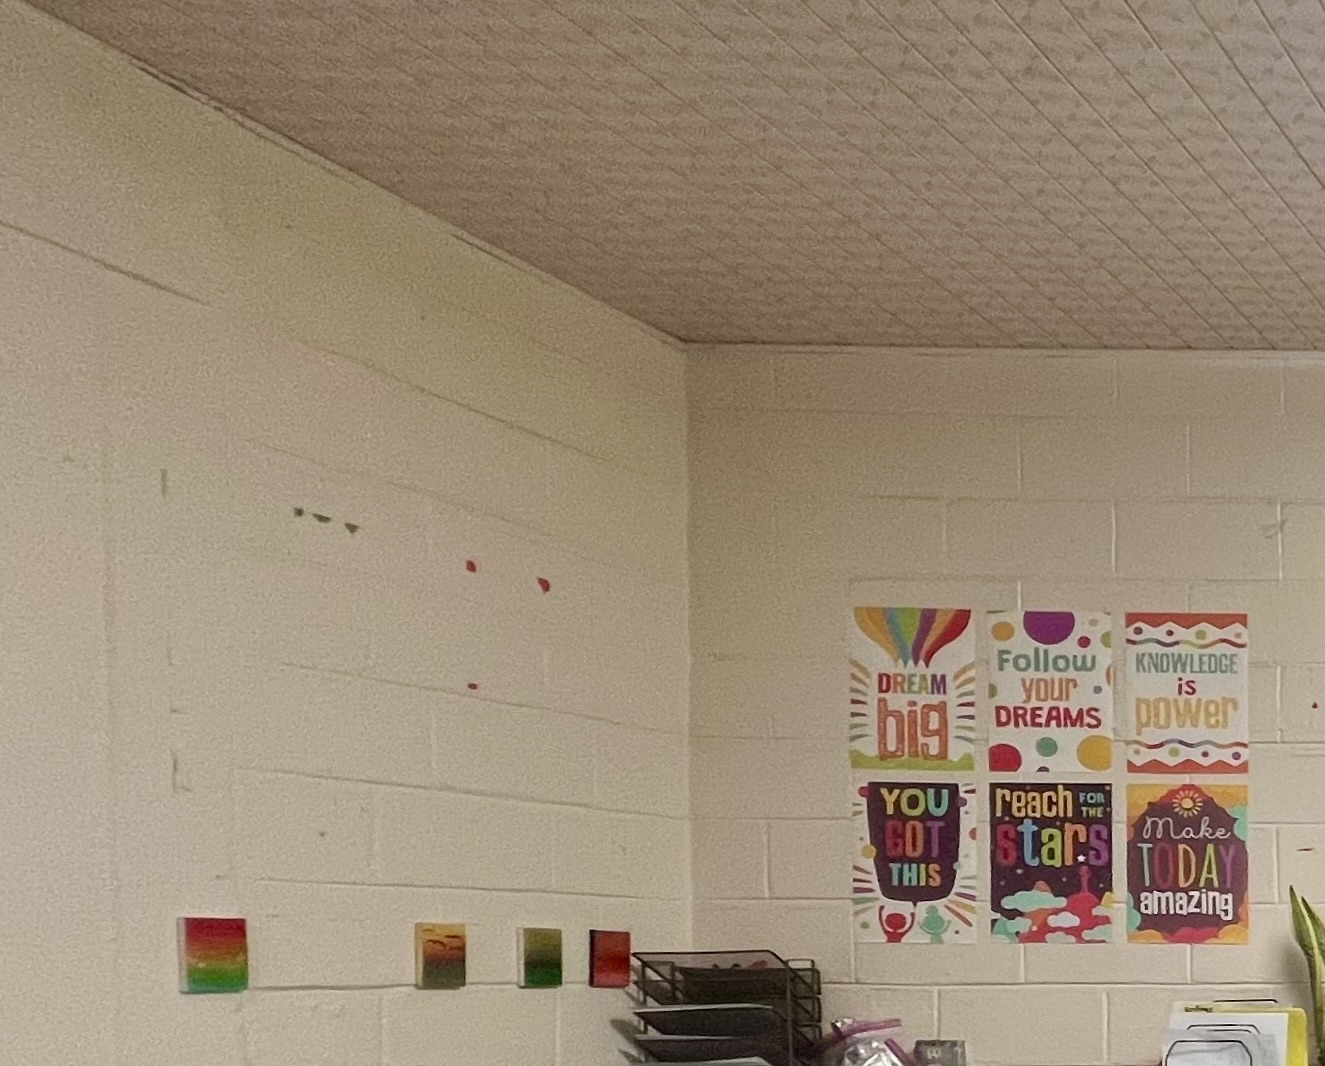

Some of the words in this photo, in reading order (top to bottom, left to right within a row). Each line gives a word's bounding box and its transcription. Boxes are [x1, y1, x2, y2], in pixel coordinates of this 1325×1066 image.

[997, 647, 1097, 673] Follow
[1135, 652, 1239, 674] KNOWLEDGE
[878, 672, 947, 695] DREAM
[1020, 677, 1078, 704] your
[1177, 676, 1197, 696] is
[877, 696, 949, 761] big
[994, 705, 1102, 729] DREAMS
[1135, 696, 1240, 737] power
[879, 787, 949, 817] YOU
[995, 784, 1074, 819] reach
[1078, 792, 1105, 804] FOR
[1080, 806, 1104, 818] THE
[885, 820, 946, 859] GOT
[1142, 815, 1232, 839] Make
[995, 818, 1110, 868] stars
[888, 862, 942, 888] THIS
[1136, 842, 1236, 889] TODAY
[1139, 888, 1234, 921] amazing
